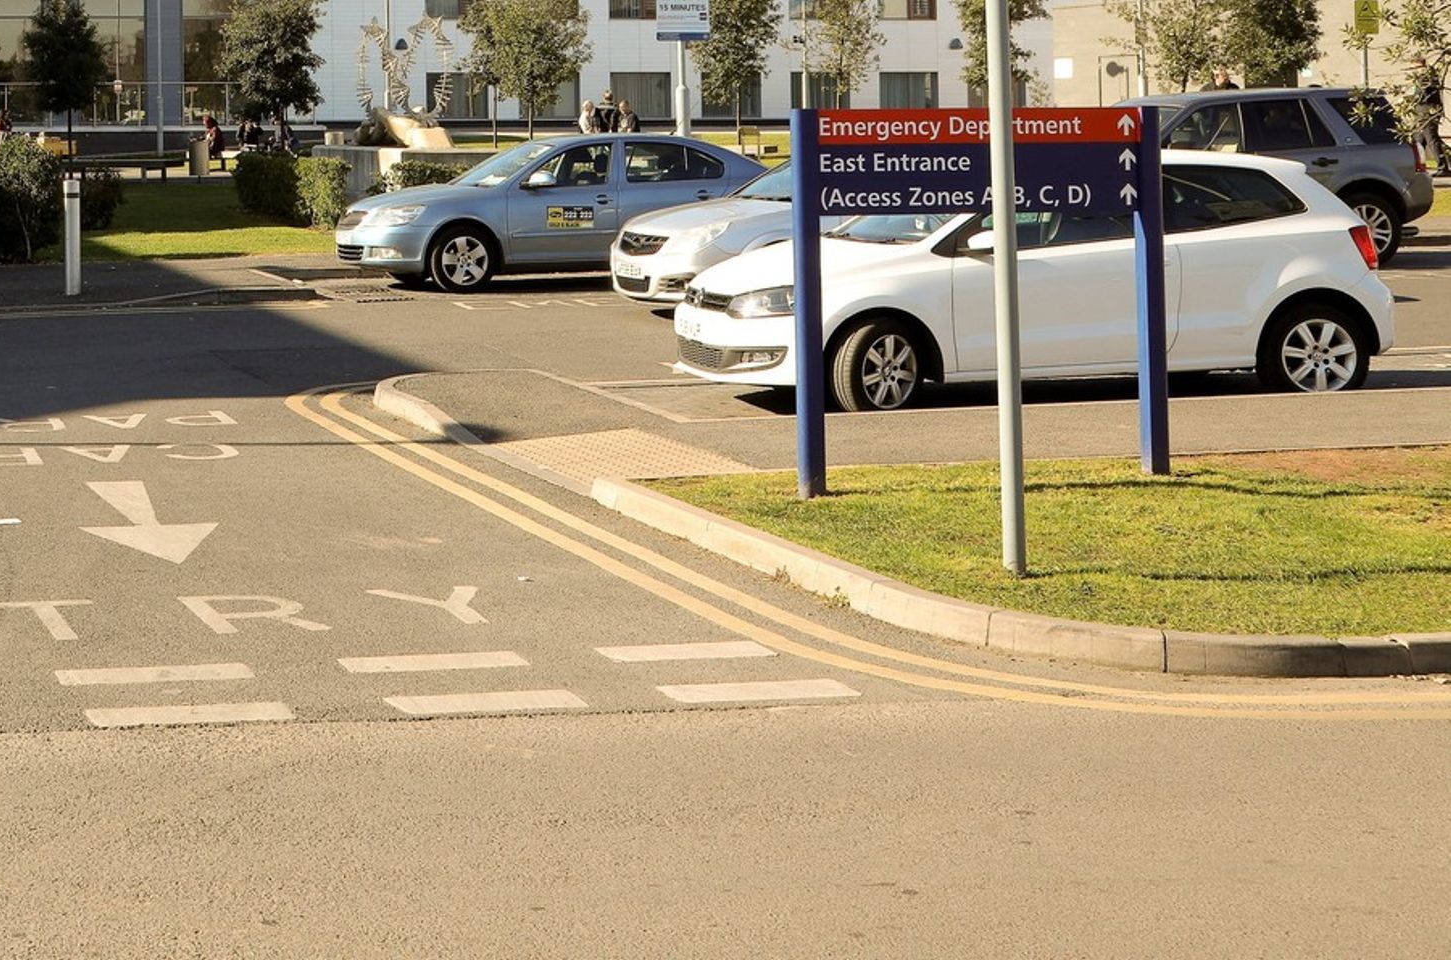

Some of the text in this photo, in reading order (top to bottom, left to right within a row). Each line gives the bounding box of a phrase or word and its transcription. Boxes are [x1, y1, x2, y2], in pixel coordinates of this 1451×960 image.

[659, 4, 707, 12] 15 MINUTES
[818, 116, 1082, 140] Emergency Deptment
[819, 153, 971, 172] East Entrance
[821, 187, 902, 210] (Access
[909, 187, 974, 206] Zones
[1039, 186, 1060, 207] C,
[1068, 184, 1092, 207] D)
